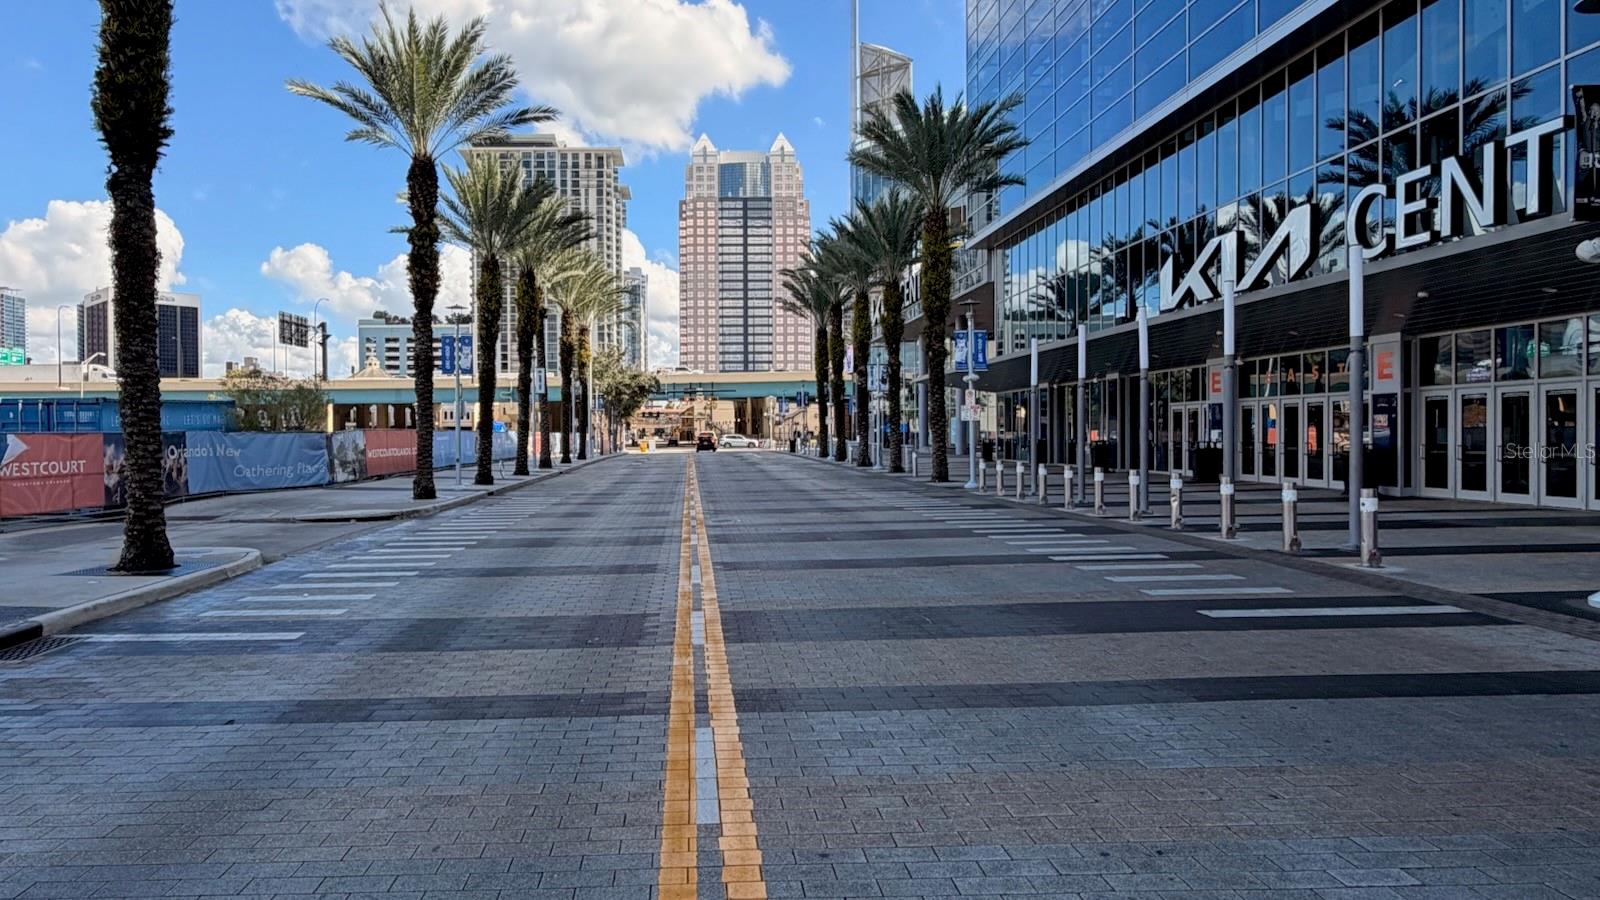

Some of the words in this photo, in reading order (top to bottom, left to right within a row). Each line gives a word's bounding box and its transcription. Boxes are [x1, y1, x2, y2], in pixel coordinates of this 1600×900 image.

[1159, 203, 1311, 311] KIA
[1376, 352, 1393, 380] E
[1211, 372, 1222, 393] E
[167, 443, 213, 459] Orlando's
[216, 443, 241, 457] New
[0, 460, 86, 477] WESTCOURT
[233, 463, 293, 478] Gathering
